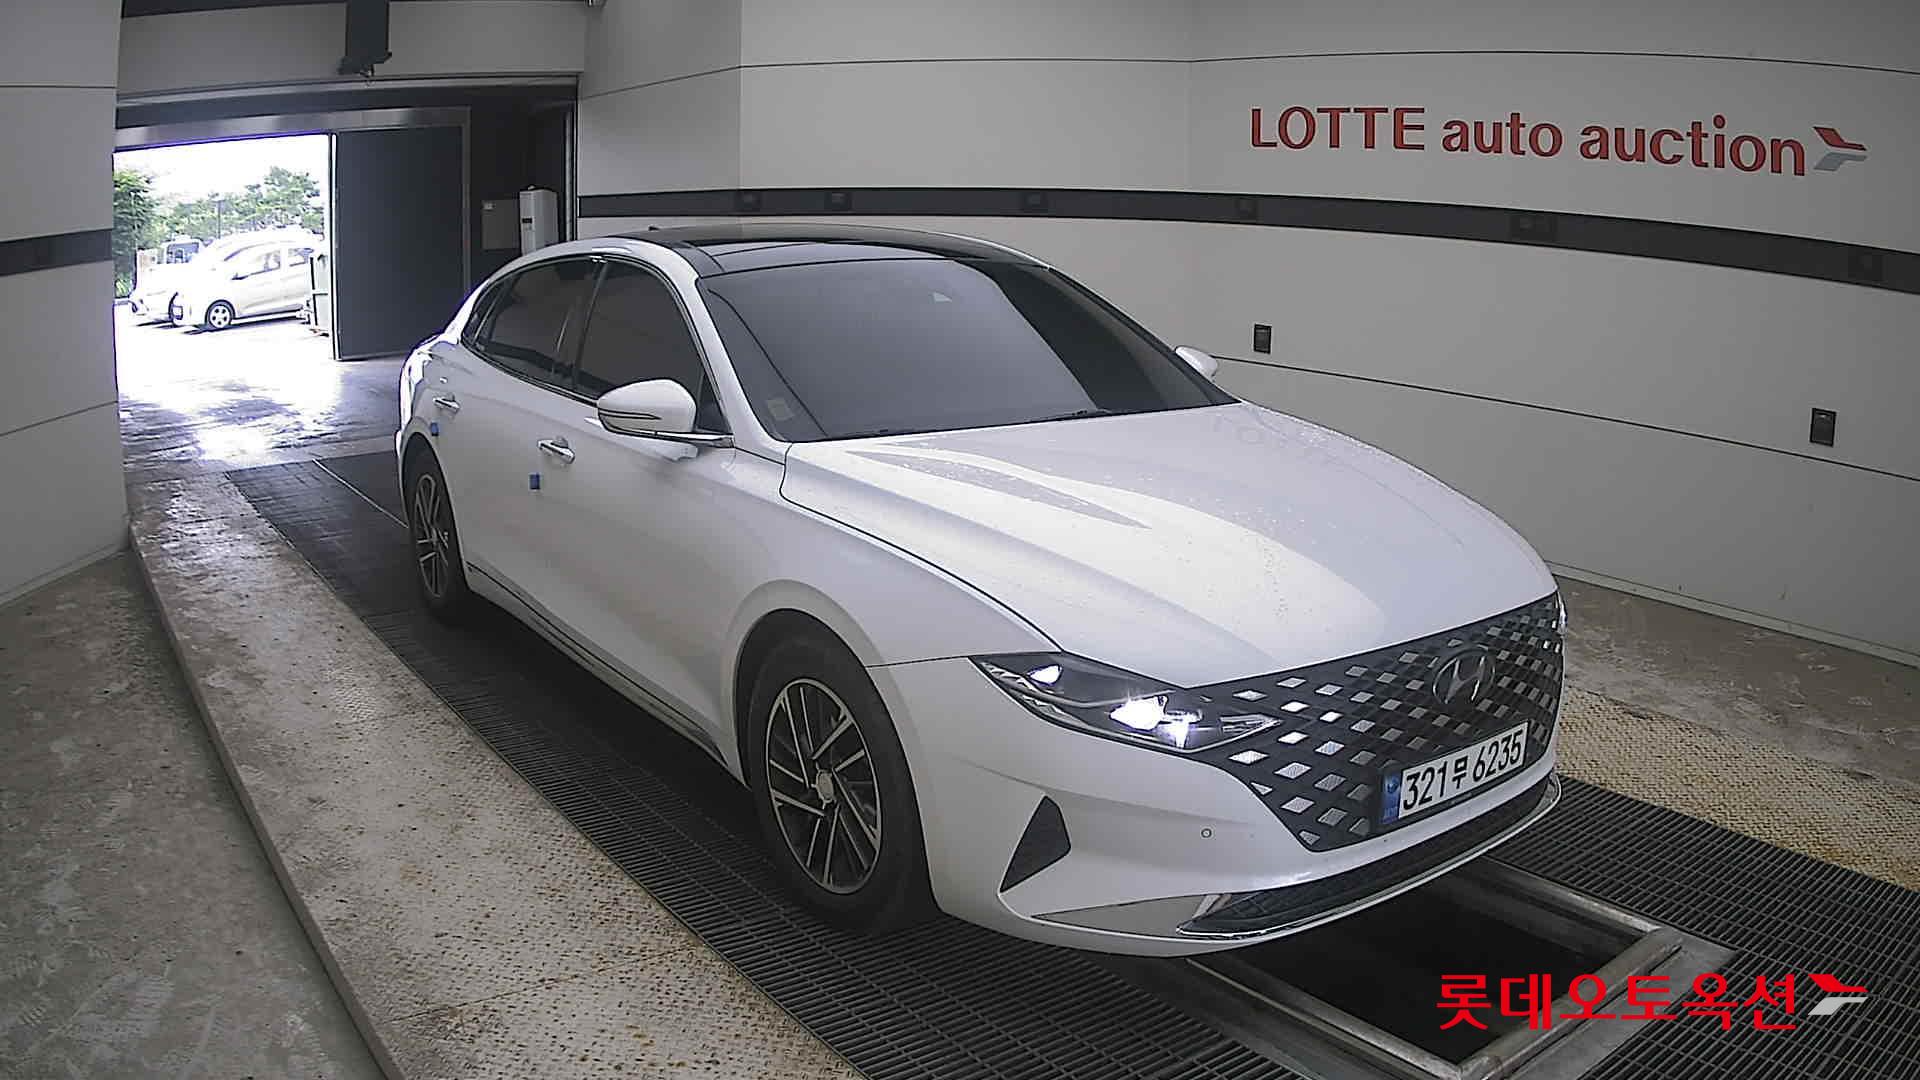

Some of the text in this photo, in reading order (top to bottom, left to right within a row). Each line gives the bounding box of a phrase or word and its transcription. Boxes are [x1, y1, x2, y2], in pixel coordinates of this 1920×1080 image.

[1250, 106, 1806, 177] LOTTE auto auction
[1403, 729, 1524, 810] 321무 6235
